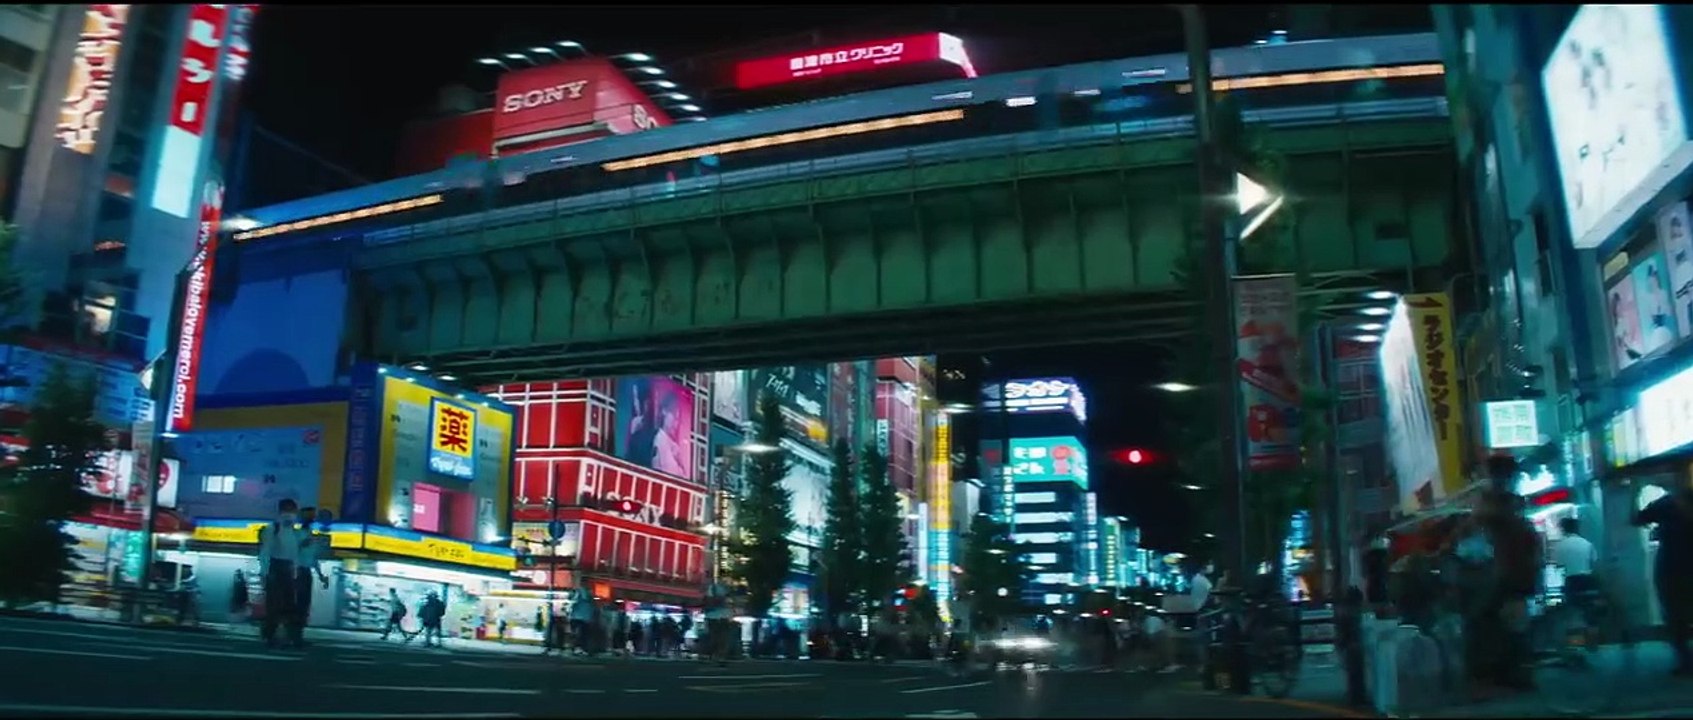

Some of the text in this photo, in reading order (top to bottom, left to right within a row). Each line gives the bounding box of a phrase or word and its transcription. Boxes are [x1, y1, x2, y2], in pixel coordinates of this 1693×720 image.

[502, 80, 588, 112] SONY
[1423, 315, 1449, 441] ラジオセンター
[440, 407, 468, 452] 薬
